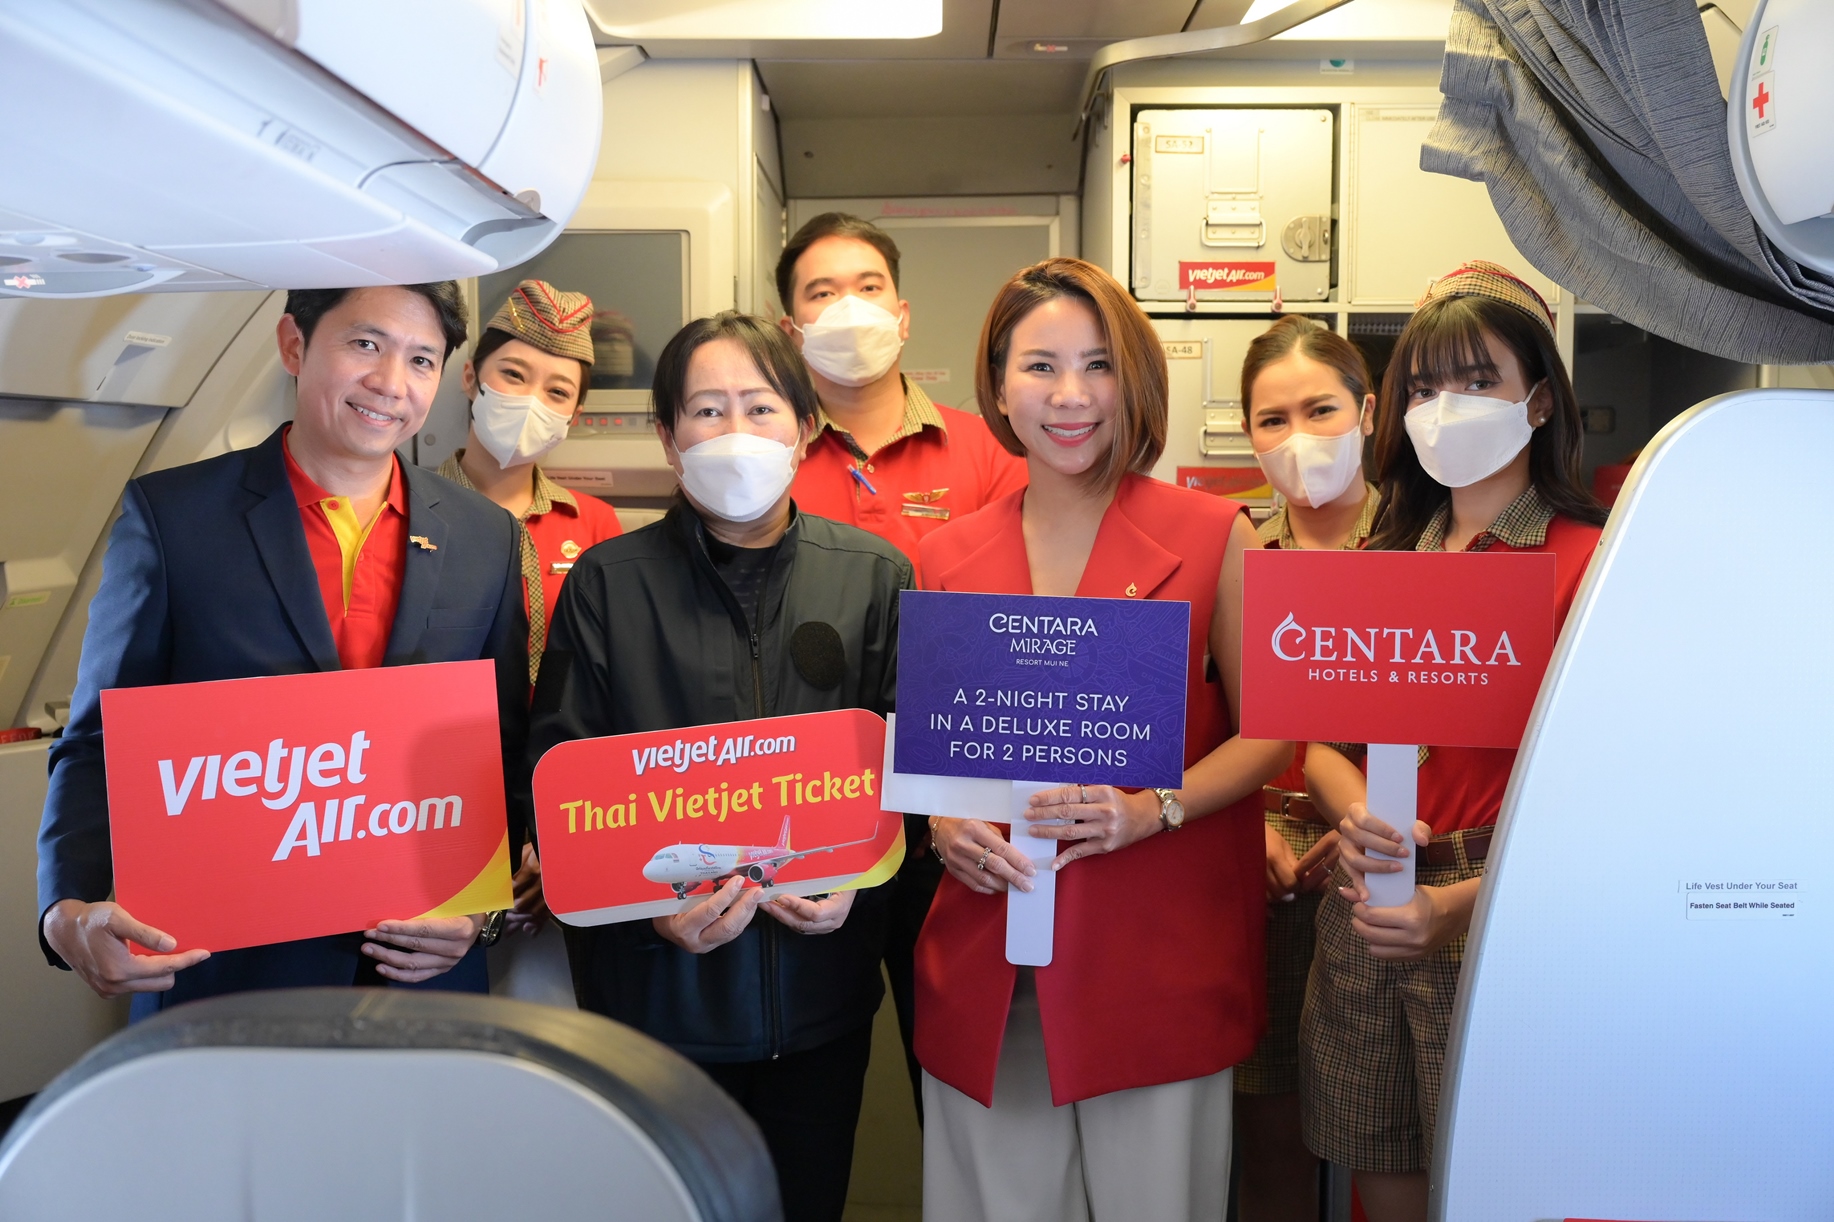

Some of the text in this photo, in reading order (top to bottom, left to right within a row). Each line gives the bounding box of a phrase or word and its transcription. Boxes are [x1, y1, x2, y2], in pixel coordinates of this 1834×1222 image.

[989, 613, 1098, 636] CENTARA
[1010, 638, 1076, 655] MIRAGE
[1271, 611, 1521, 666] CENTARA
[1015, 658, 1043, 666] RESORT
[1308, 668, 1489, 685] HOTELS & RESORTS
[954, 688, 1129, 712] A 2-NIGHT STAY
[930, 713, 1150, 741] IN A DELUXE ROOM
[950, 741, 1127, 767] FOR 2 PERSONS
[559, 768, 875, 834] Thai Vietjet Ticket
[1686, 882, 1798, 890] Life Vest Under Your Seat
